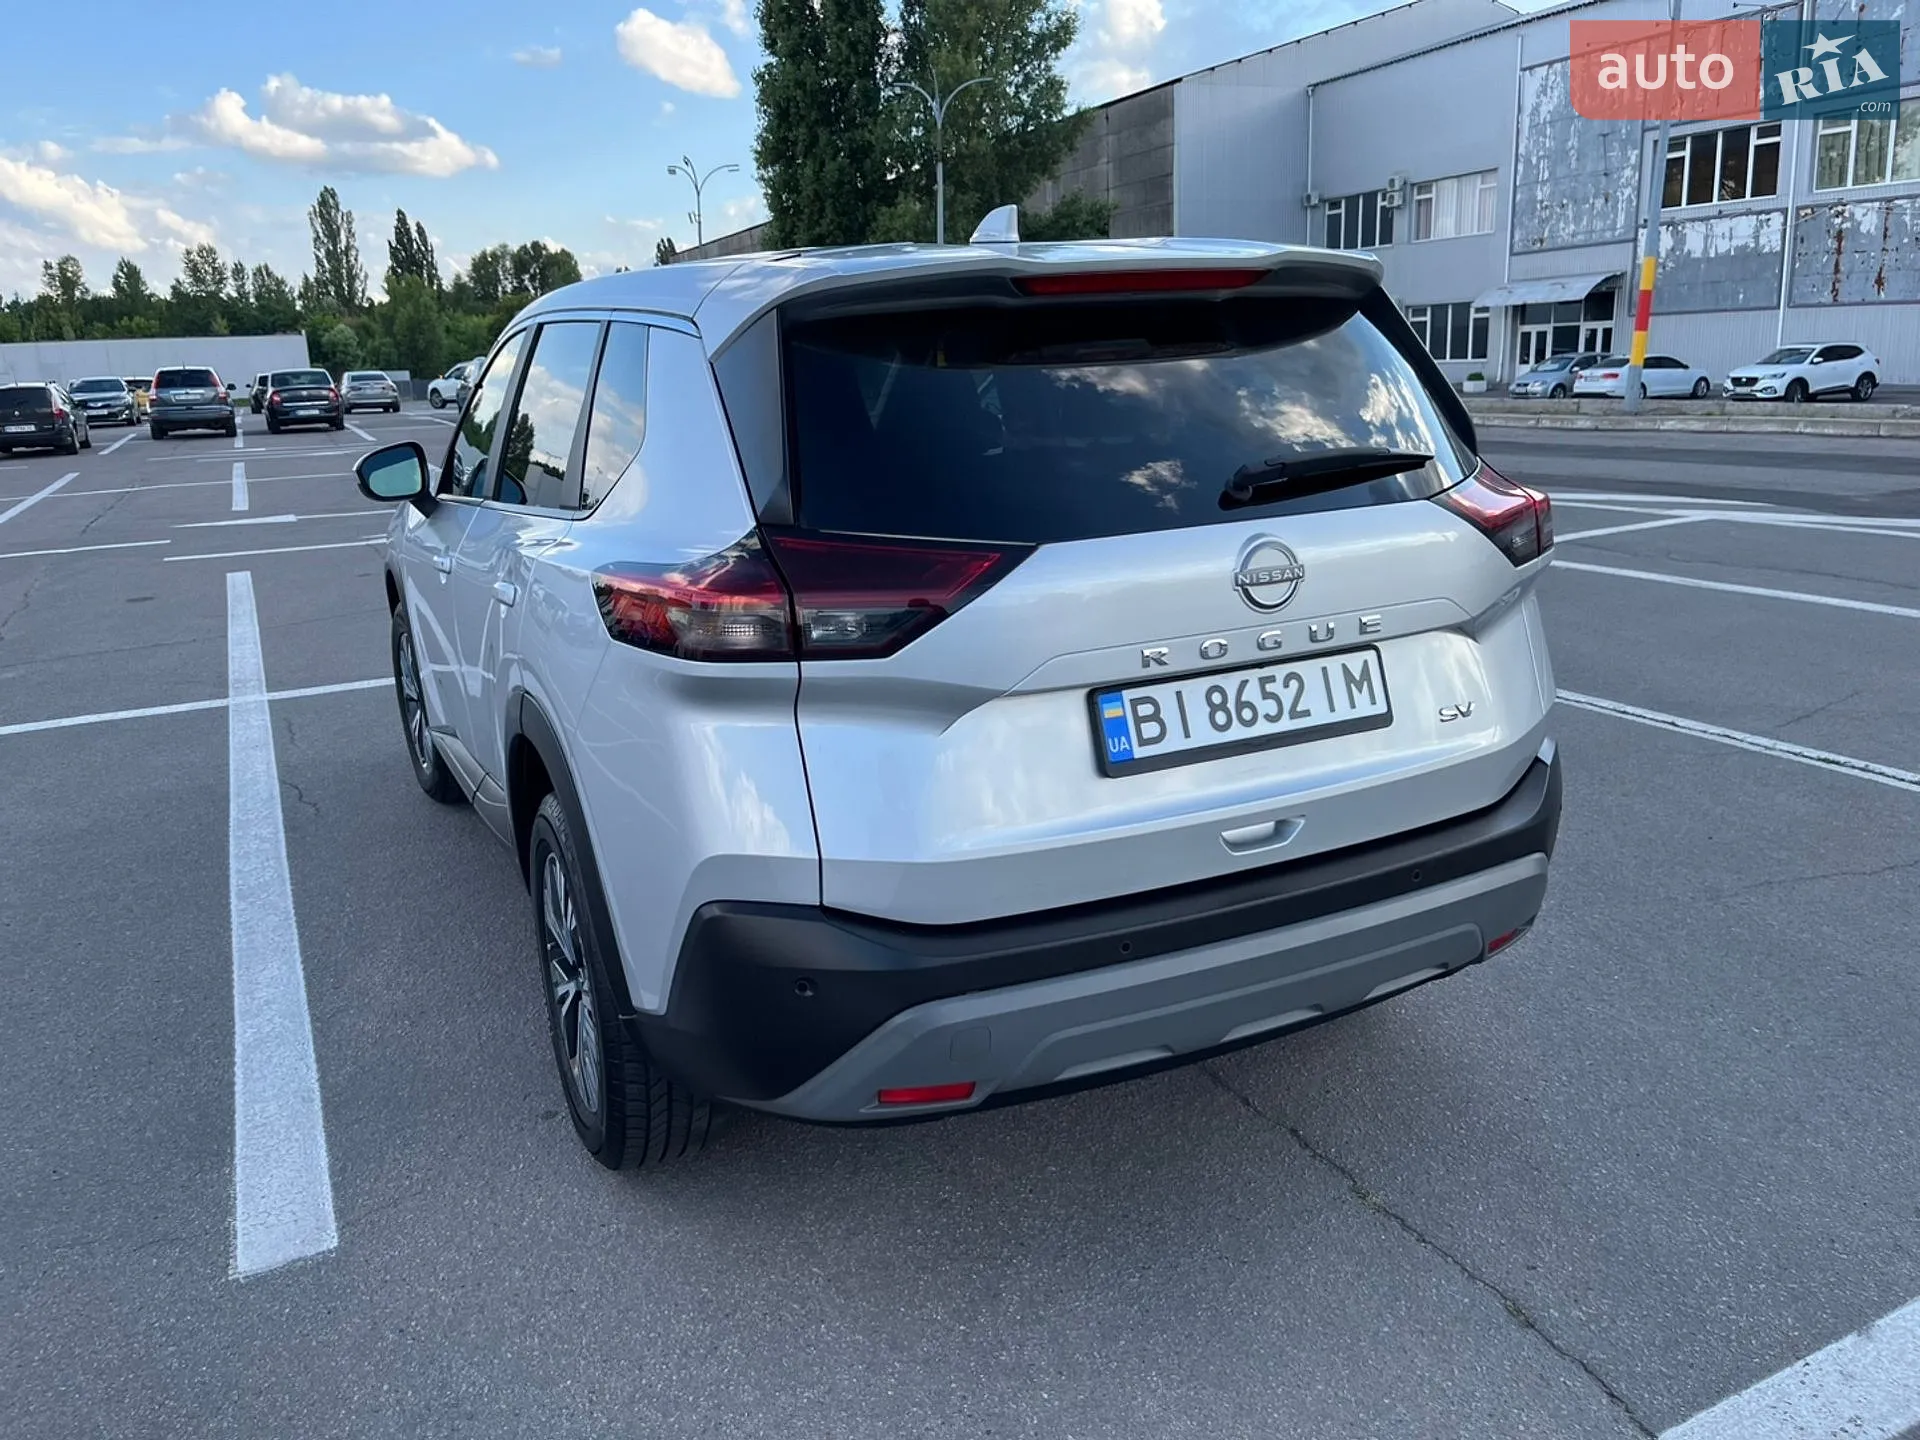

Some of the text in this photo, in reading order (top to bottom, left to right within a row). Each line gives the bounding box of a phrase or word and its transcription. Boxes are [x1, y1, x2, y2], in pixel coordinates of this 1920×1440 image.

[1238, 567, 1303, 584] NISSAN
[1141, 614, 1382, 669] ROGUE
[1129, 659, 1377, 748] BI 8652 IM
[1438, 701, 1475, 723] SV
[1108, 736, 1131, 754] UA
